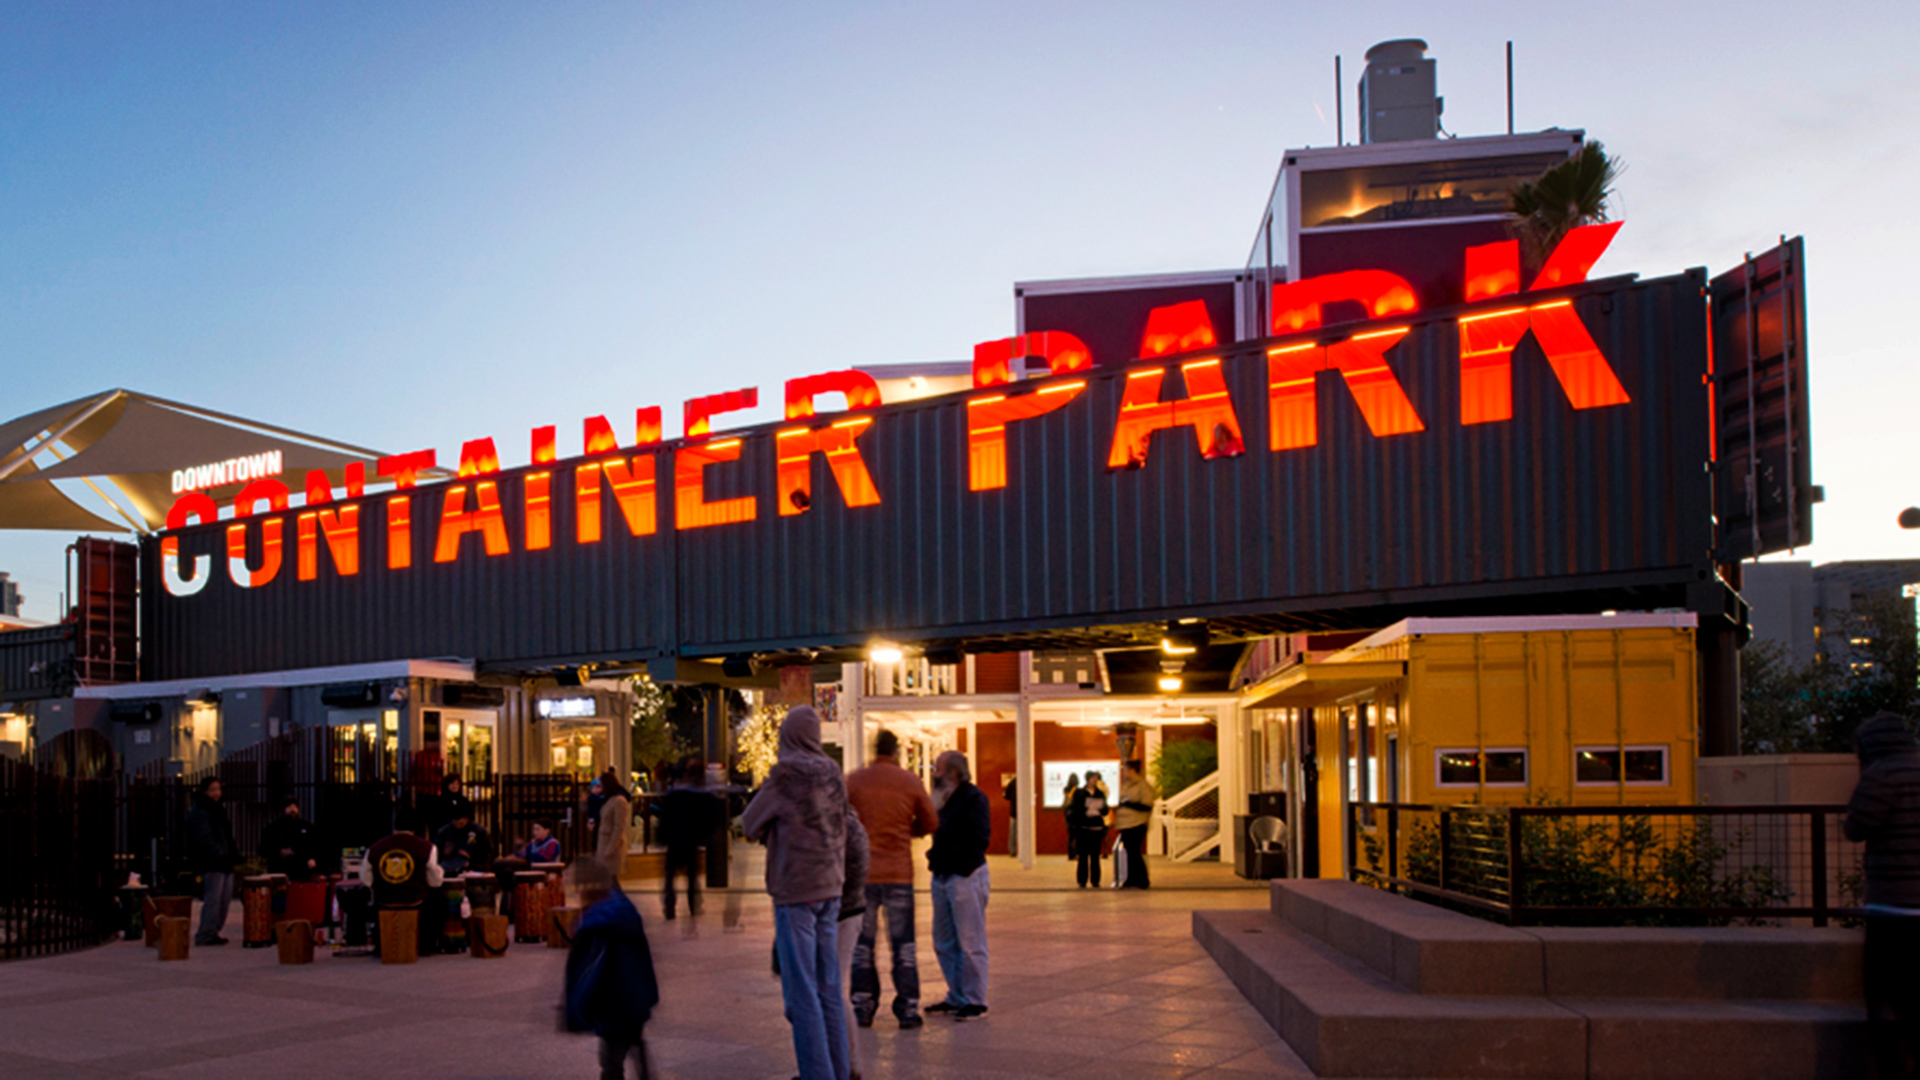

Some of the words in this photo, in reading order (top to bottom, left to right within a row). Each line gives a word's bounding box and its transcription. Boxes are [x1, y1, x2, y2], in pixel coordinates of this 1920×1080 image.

[161, 368, 882, 597] CONTAINER
[967, 220, 1631, 491] PARK
[172, 450, 282, 494] DOWNTOWN
